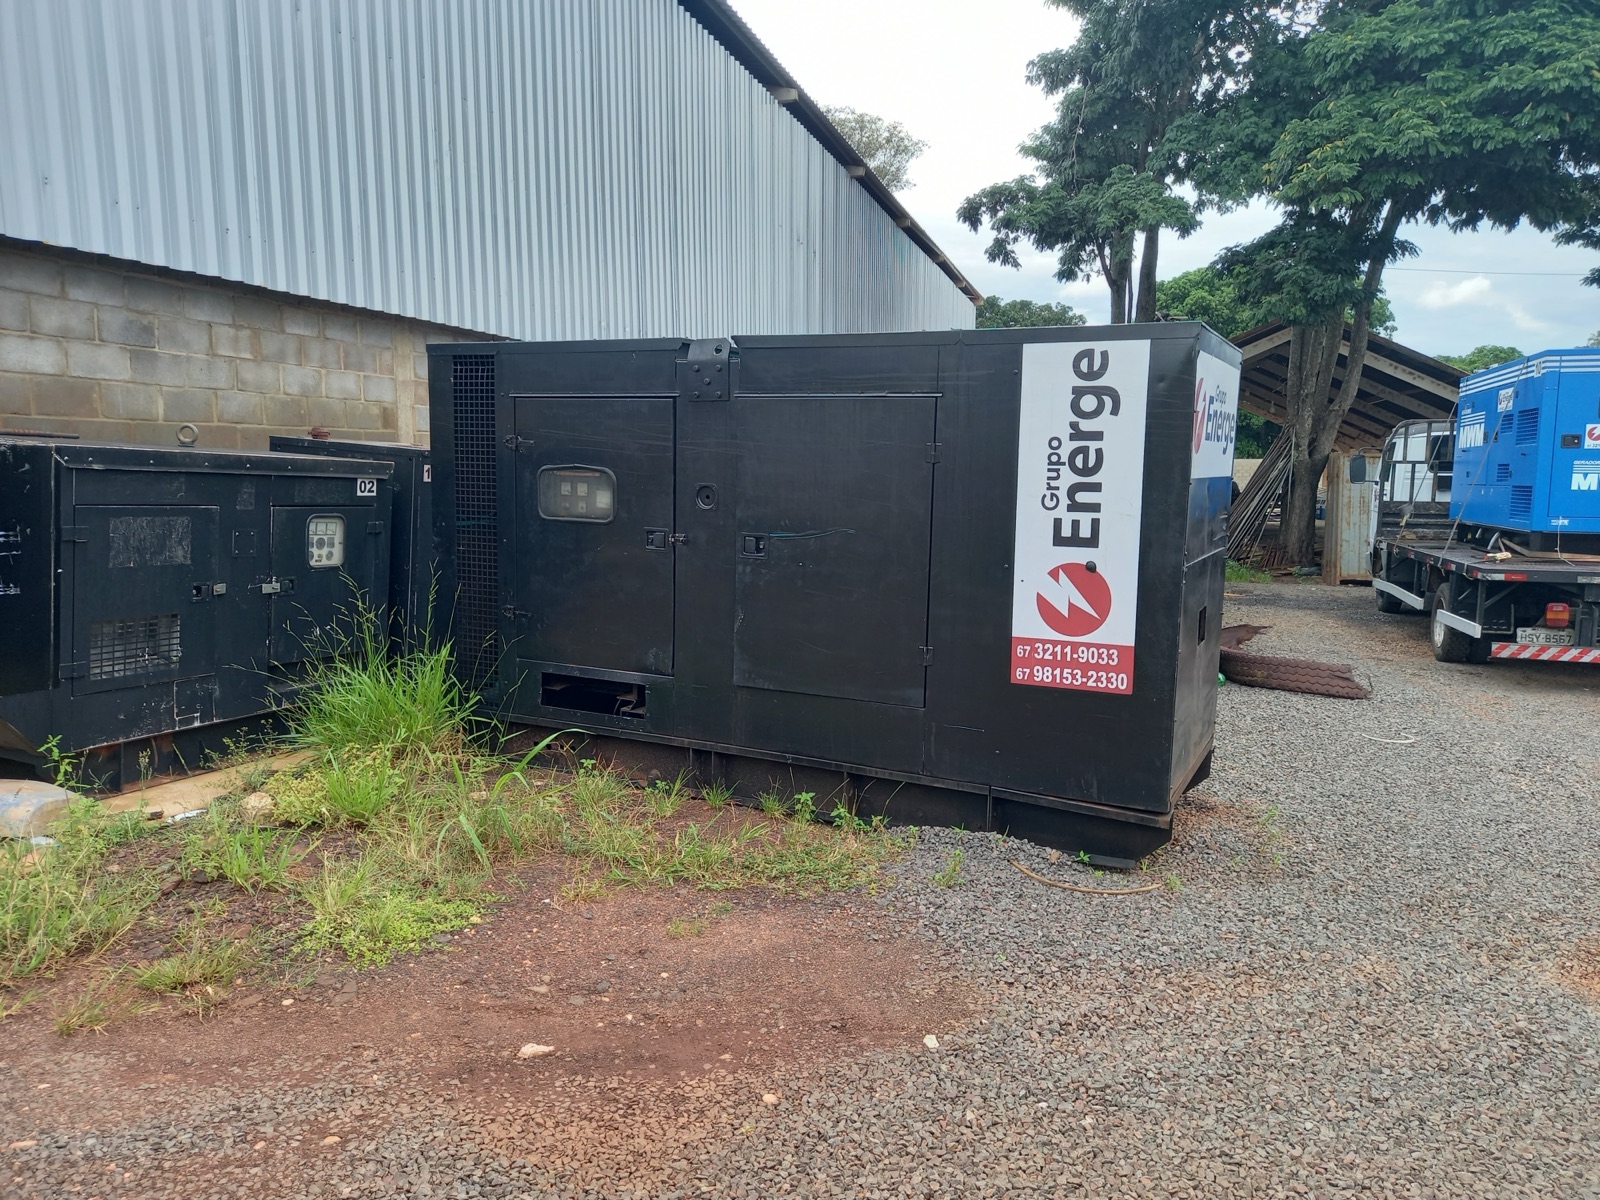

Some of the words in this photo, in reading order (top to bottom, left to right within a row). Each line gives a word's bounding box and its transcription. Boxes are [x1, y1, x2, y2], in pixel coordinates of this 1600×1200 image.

[1215, 385, 1227, 408] Grupo
[1205, 395, 1235, 455] Energe
[1459, 423, 1484, 448] MWM
[1053, 348, 1121, 548] Energe
[1041, 436, 1066, 511] Grupo
[359, 480, 375, 493] 02
[1017, 645, 1031, 658] 67
[1034, 643, 1119, 666] 3211-9033
[1016, 668, 1031, 680] 67
[1033, 665, 1128, 690] 98153-2330
